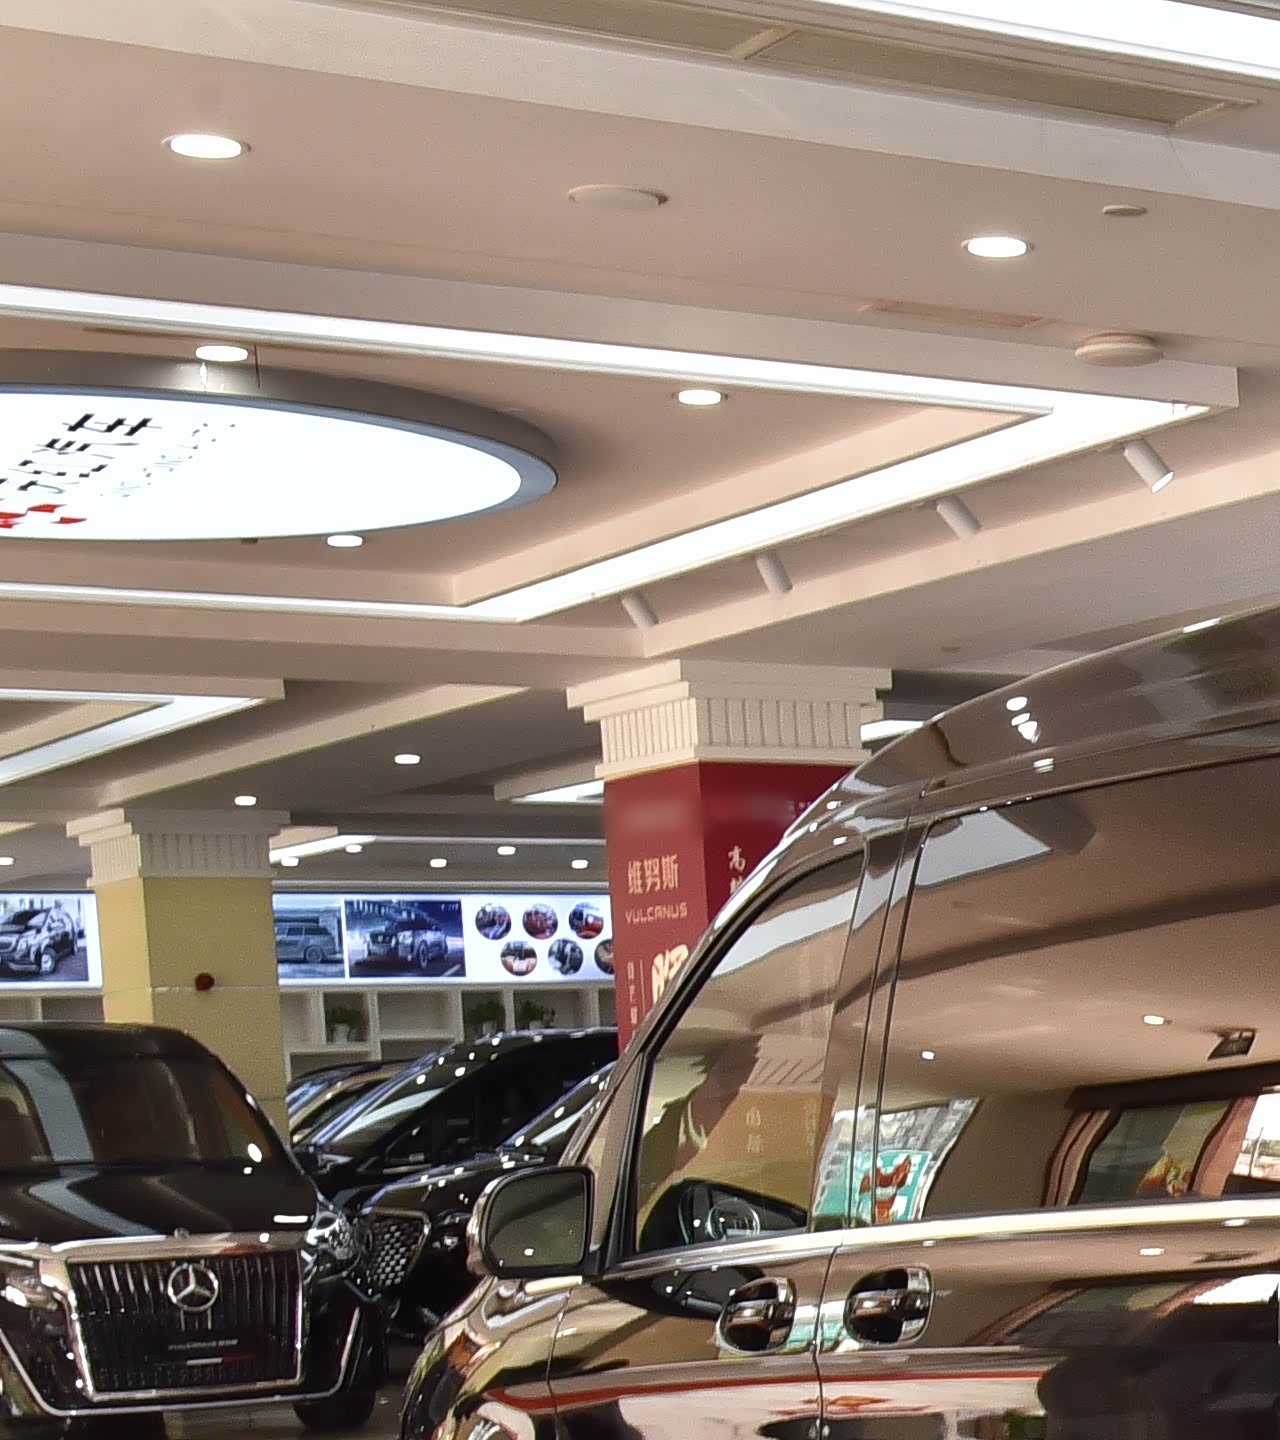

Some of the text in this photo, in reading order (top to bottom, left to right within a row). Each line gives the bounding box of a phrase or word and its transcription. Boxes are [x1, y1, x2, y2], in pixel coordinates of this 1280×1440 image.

[626, 853, 679, 895] 维努斯
[624, 900, 688, 925] VULCANUS
